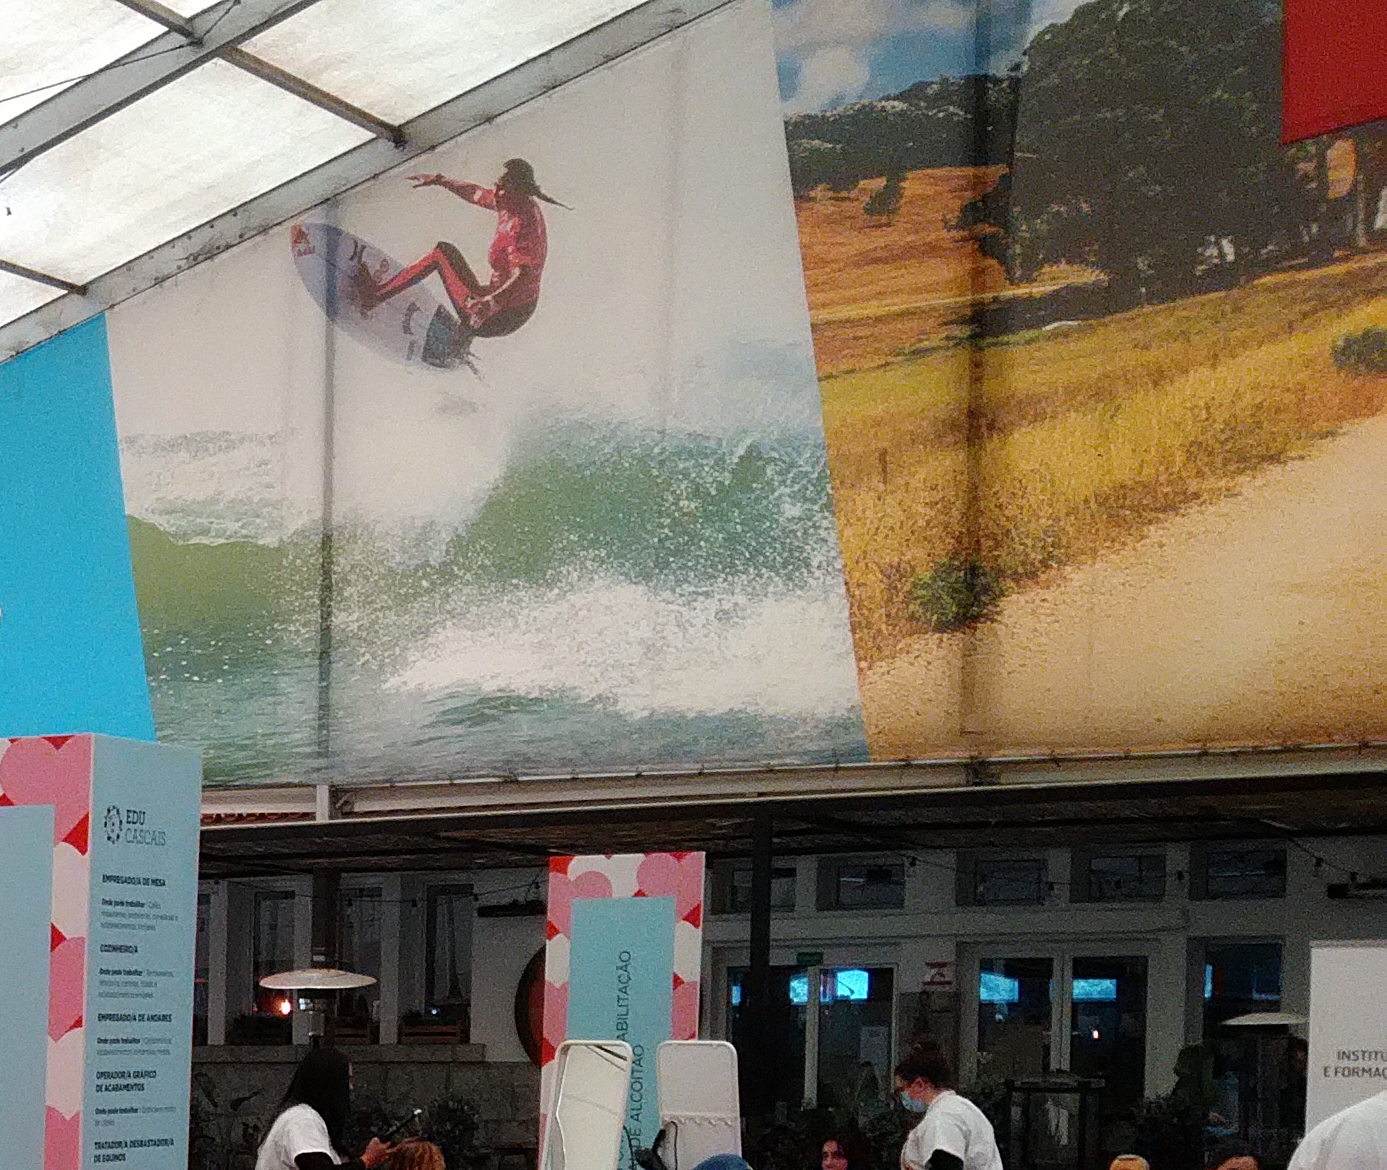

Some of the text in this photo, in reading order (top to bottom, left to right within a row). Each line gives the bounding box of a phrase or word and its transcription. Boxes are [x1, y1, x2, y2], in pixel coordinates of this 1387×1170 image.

[125, 809, 147, 826] EDU
[125, 828, 167, 847] CASCAIS
[142, 877, 151, 886] DE
[151, 878, 166, 887] MESA
[616, 950, 633, 1041] ABILITAÇÃO
[1323, 1065, 1331, 1078] E
[628, 1127, 642, 1149] DE
